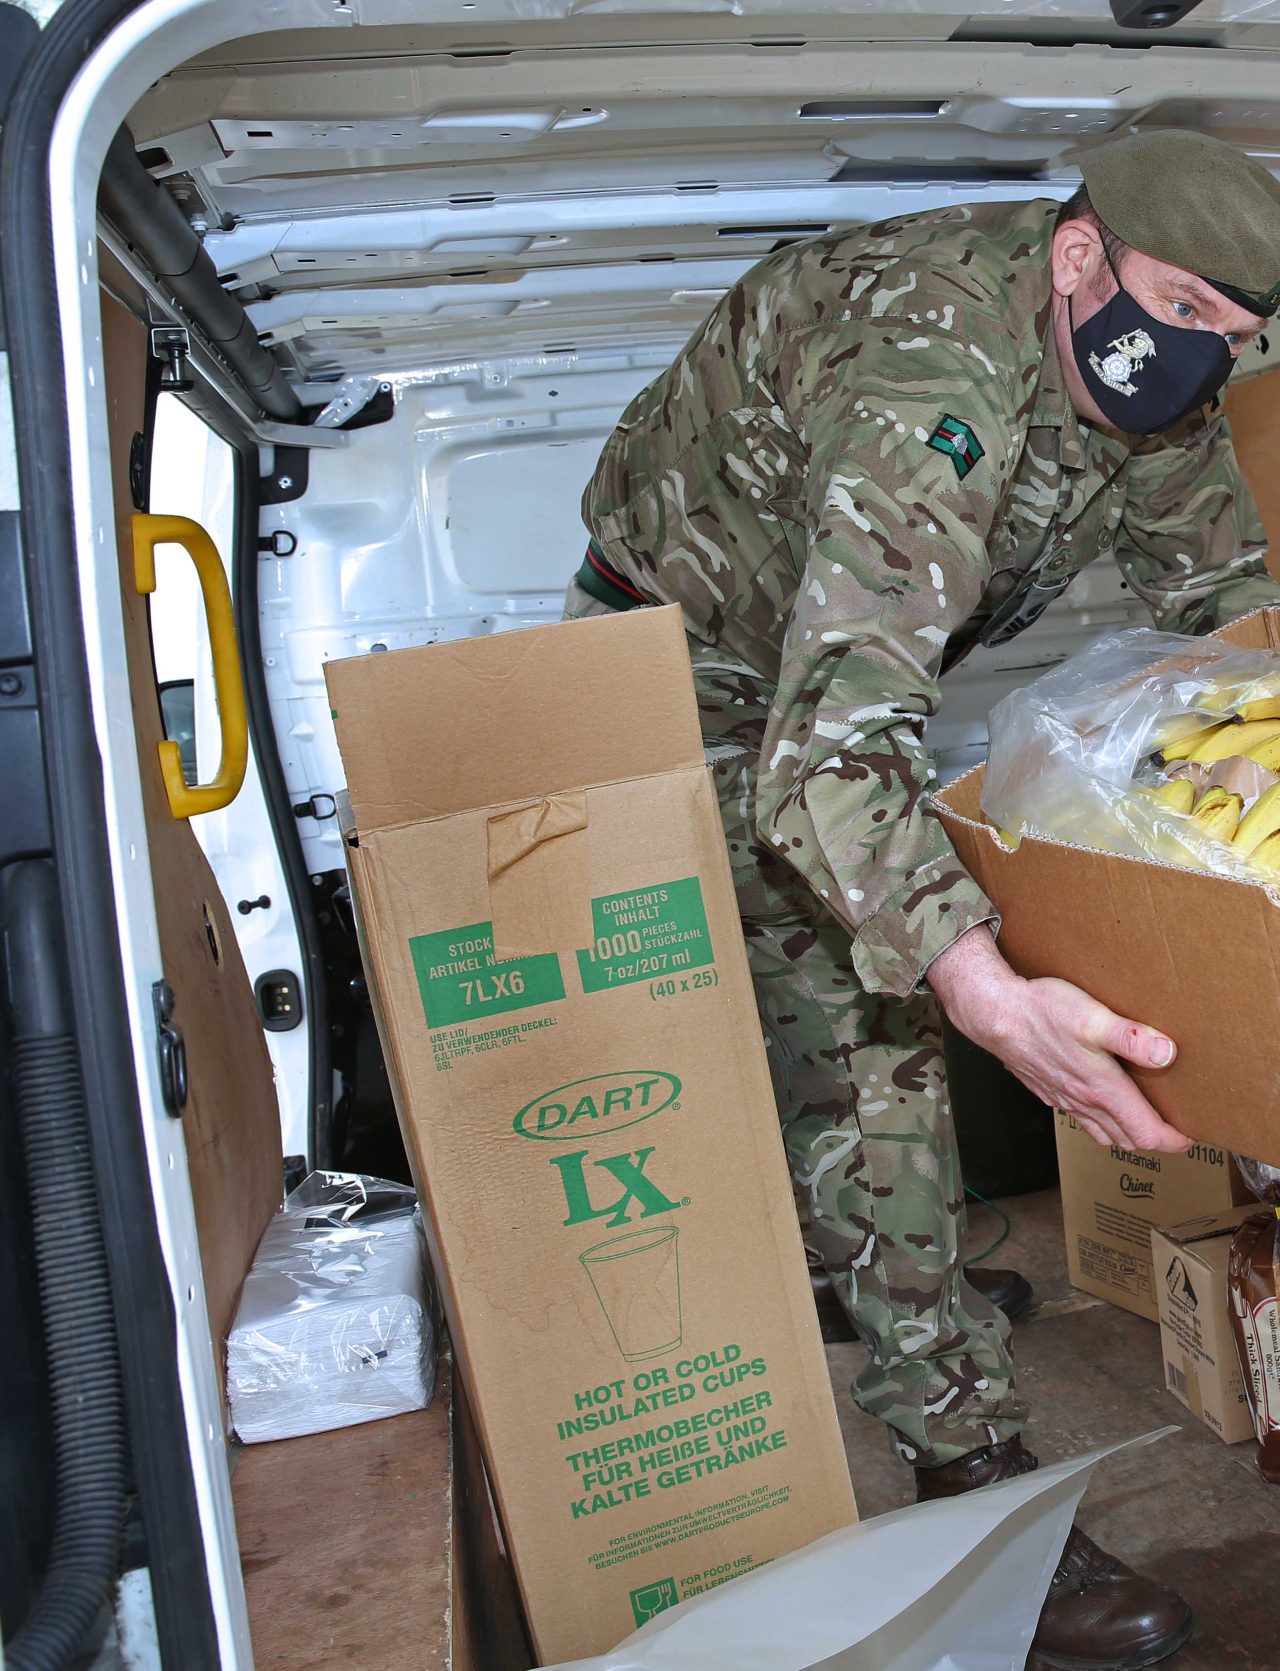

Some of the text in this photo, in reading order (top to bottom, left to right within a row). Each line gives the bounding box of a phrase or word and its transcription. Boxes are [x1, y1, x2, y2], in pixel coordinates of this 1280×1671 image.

[602, 889, 668, 914] CONTENTS
[614, 906, 660, 926] INHALT
[642, 921, 677, 937] PIECES
[645, 928, 703, 950] STÜCKZAHL
[448, 937, 492, 957] STOCK
[604, 948, 691, 981] 7 oz/207 ml
[430, 957, 483, 979] ARTIKEL
[650, 968, 719, 1001] (40 x 25)
[459, 971, 525, 1005] 7LX6
[430, 1028, 468, 1044] USE LID/
[432, 1017, 558, 1053] ZU VERWENDENDER DECKEL:
[536, 1078, 660, 1132] DART
[1110, 1145, 1161, 1173] Huntamaki
[549, 1146, 681, 1229] LX
[1268, 1309, 1280, 1353] Wholemeal
[574, 1343, 742, 1411] HOT OR COLD
[1246, 1334, 1263, 1404] Thick Sliced
[557, 1357, 767, 1441] INSULATED CUPS
[565, 1390, 773, 1472] THERMOBECHER
[582, 1463, 633, 1491] FÜR
[716, 1415, 767, 1446] UND
[570, 1430, 788, 1520] KALTE GETRÄNKE
[588, 1485, 793, 1564] FÜR INFORMATIONEN ZUR UMWELTVERTRÄGLICHKEIT,
[595, 1495, 789, 1570] BESUCHEN SIE WWW.DARTPRODUCTSEUROPE.COM
[609, 1485, 769, 1547] FOR ENVIRONMENTAL INFORMATION, VISIT
[681, 1554, 754, 1587] FOR FOOD USE
[683, 1585, 704, 1599] FÜR
